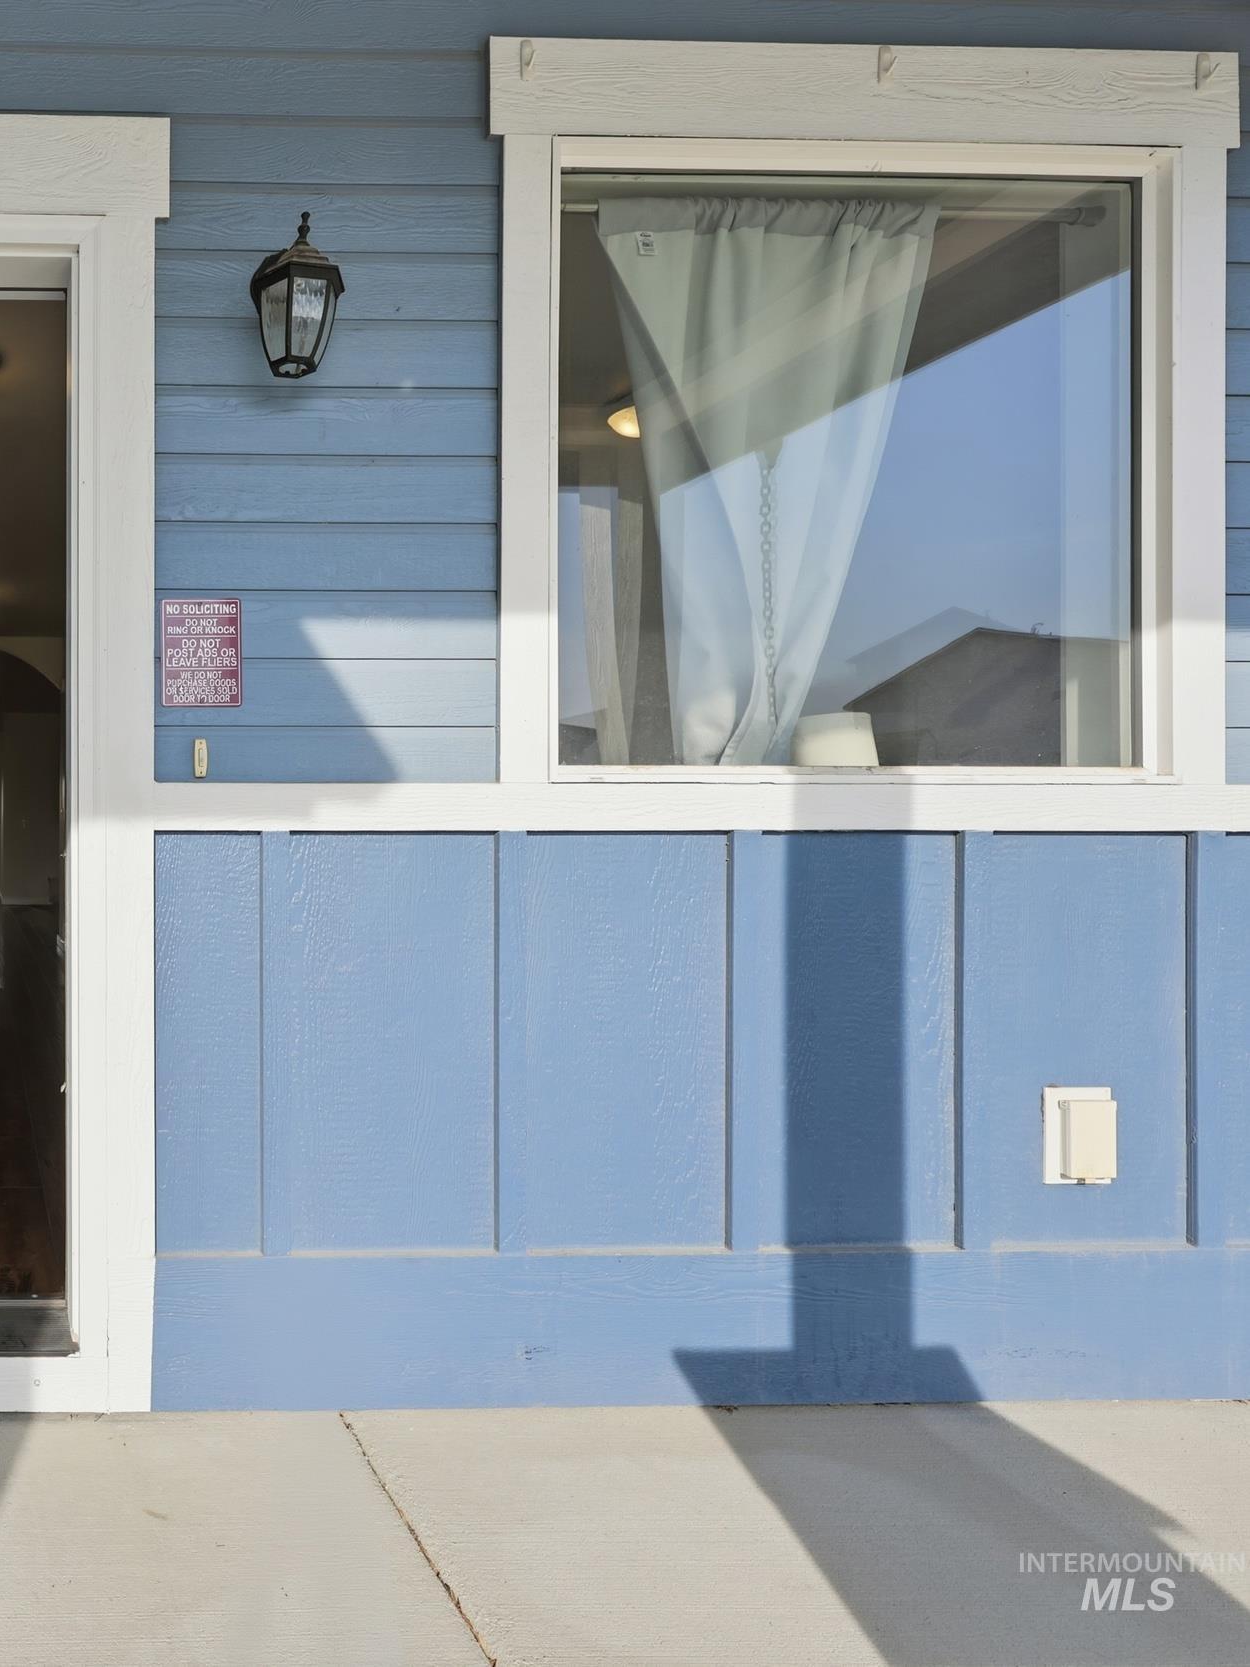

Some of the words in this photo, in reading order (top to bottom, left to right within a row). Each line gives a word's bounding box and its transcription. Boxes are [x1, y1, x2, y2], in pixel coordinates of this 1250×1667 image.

[167, 605, 180, 614] NO
[183, 604, 236, 614] SOLICITING
[200, 639, 220, 647] NOT
[168, 649, 195, 657] POST
[197, 648, 218, 657] ADS
[221, 648, 235, 656] OR
[166, 658, 198, 666] LEAVE
[202, 657, 237, 666] FLIERS
